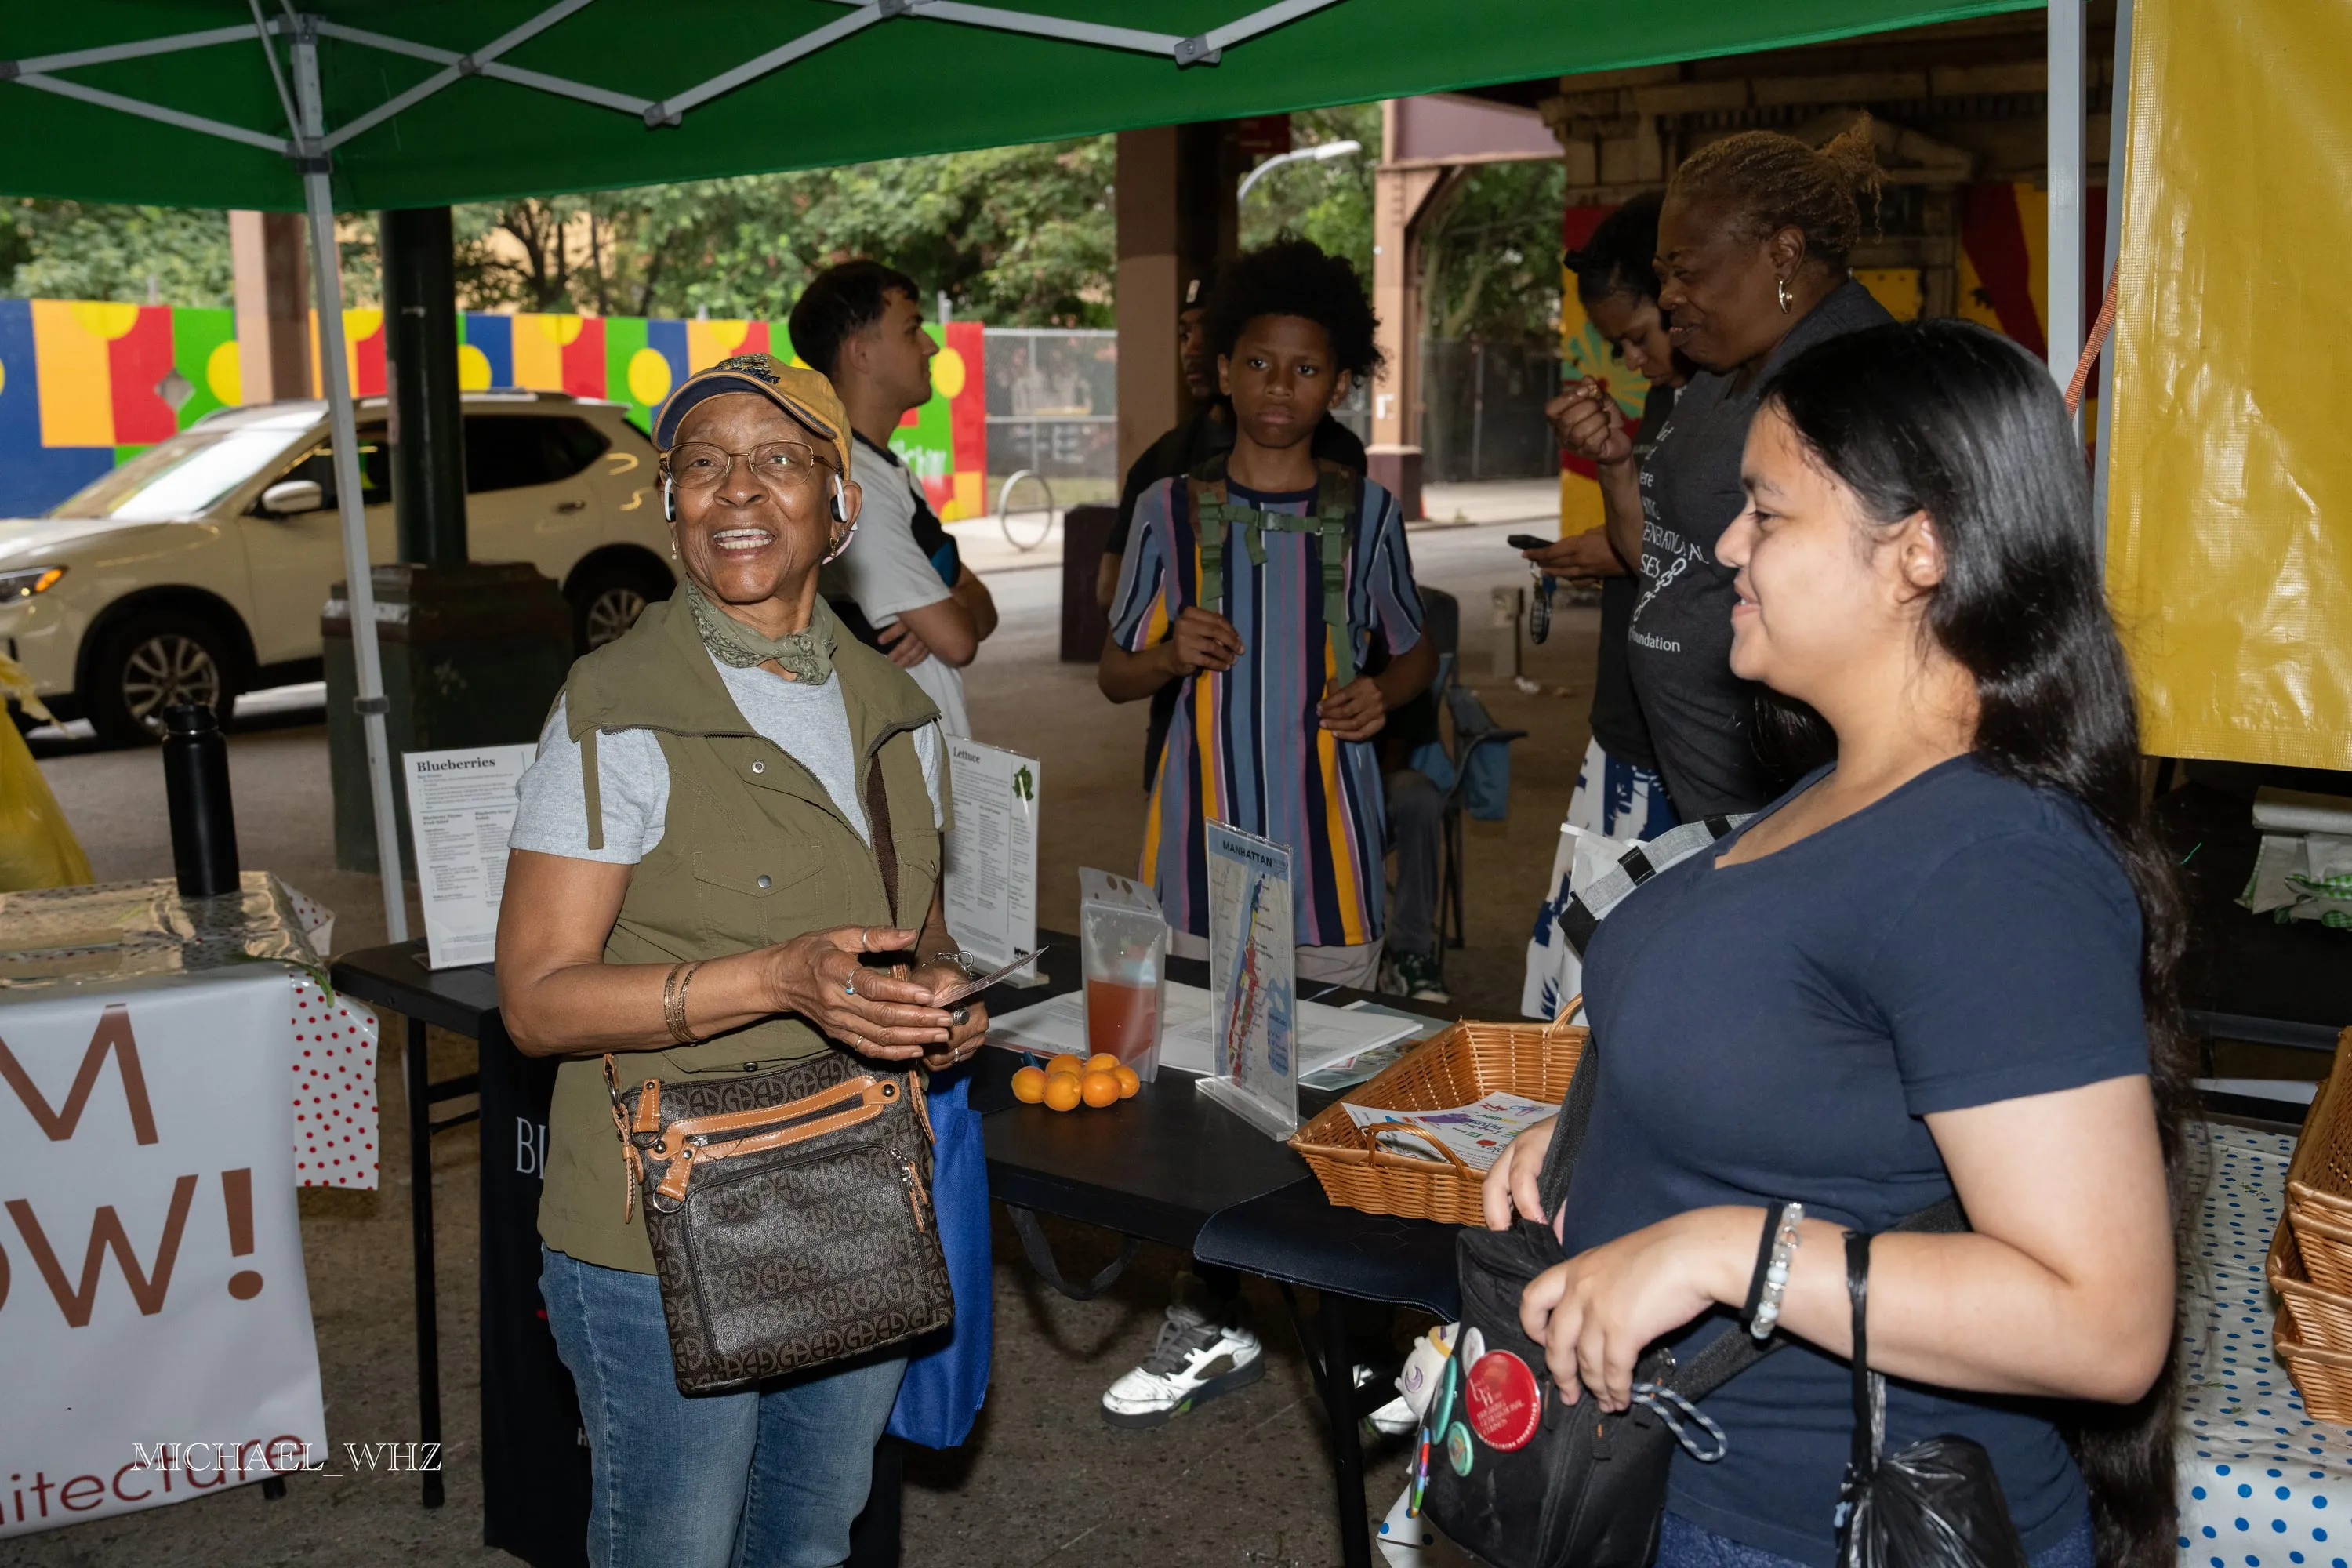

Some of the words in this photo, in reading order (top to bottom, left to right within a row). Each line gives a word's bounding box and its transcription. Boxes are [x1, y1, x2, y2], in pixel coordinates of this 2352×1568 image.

[416, 757, 496, 772] Blueberries
[953, 746, 981, 764] Lettuce
[1222, 840, 1272, 868] MANHATTAN
[0, 1003, 159, 1145] M
[0, 1167, 264, 1329] W!
[0, 1434, 307, 1526] itecture
